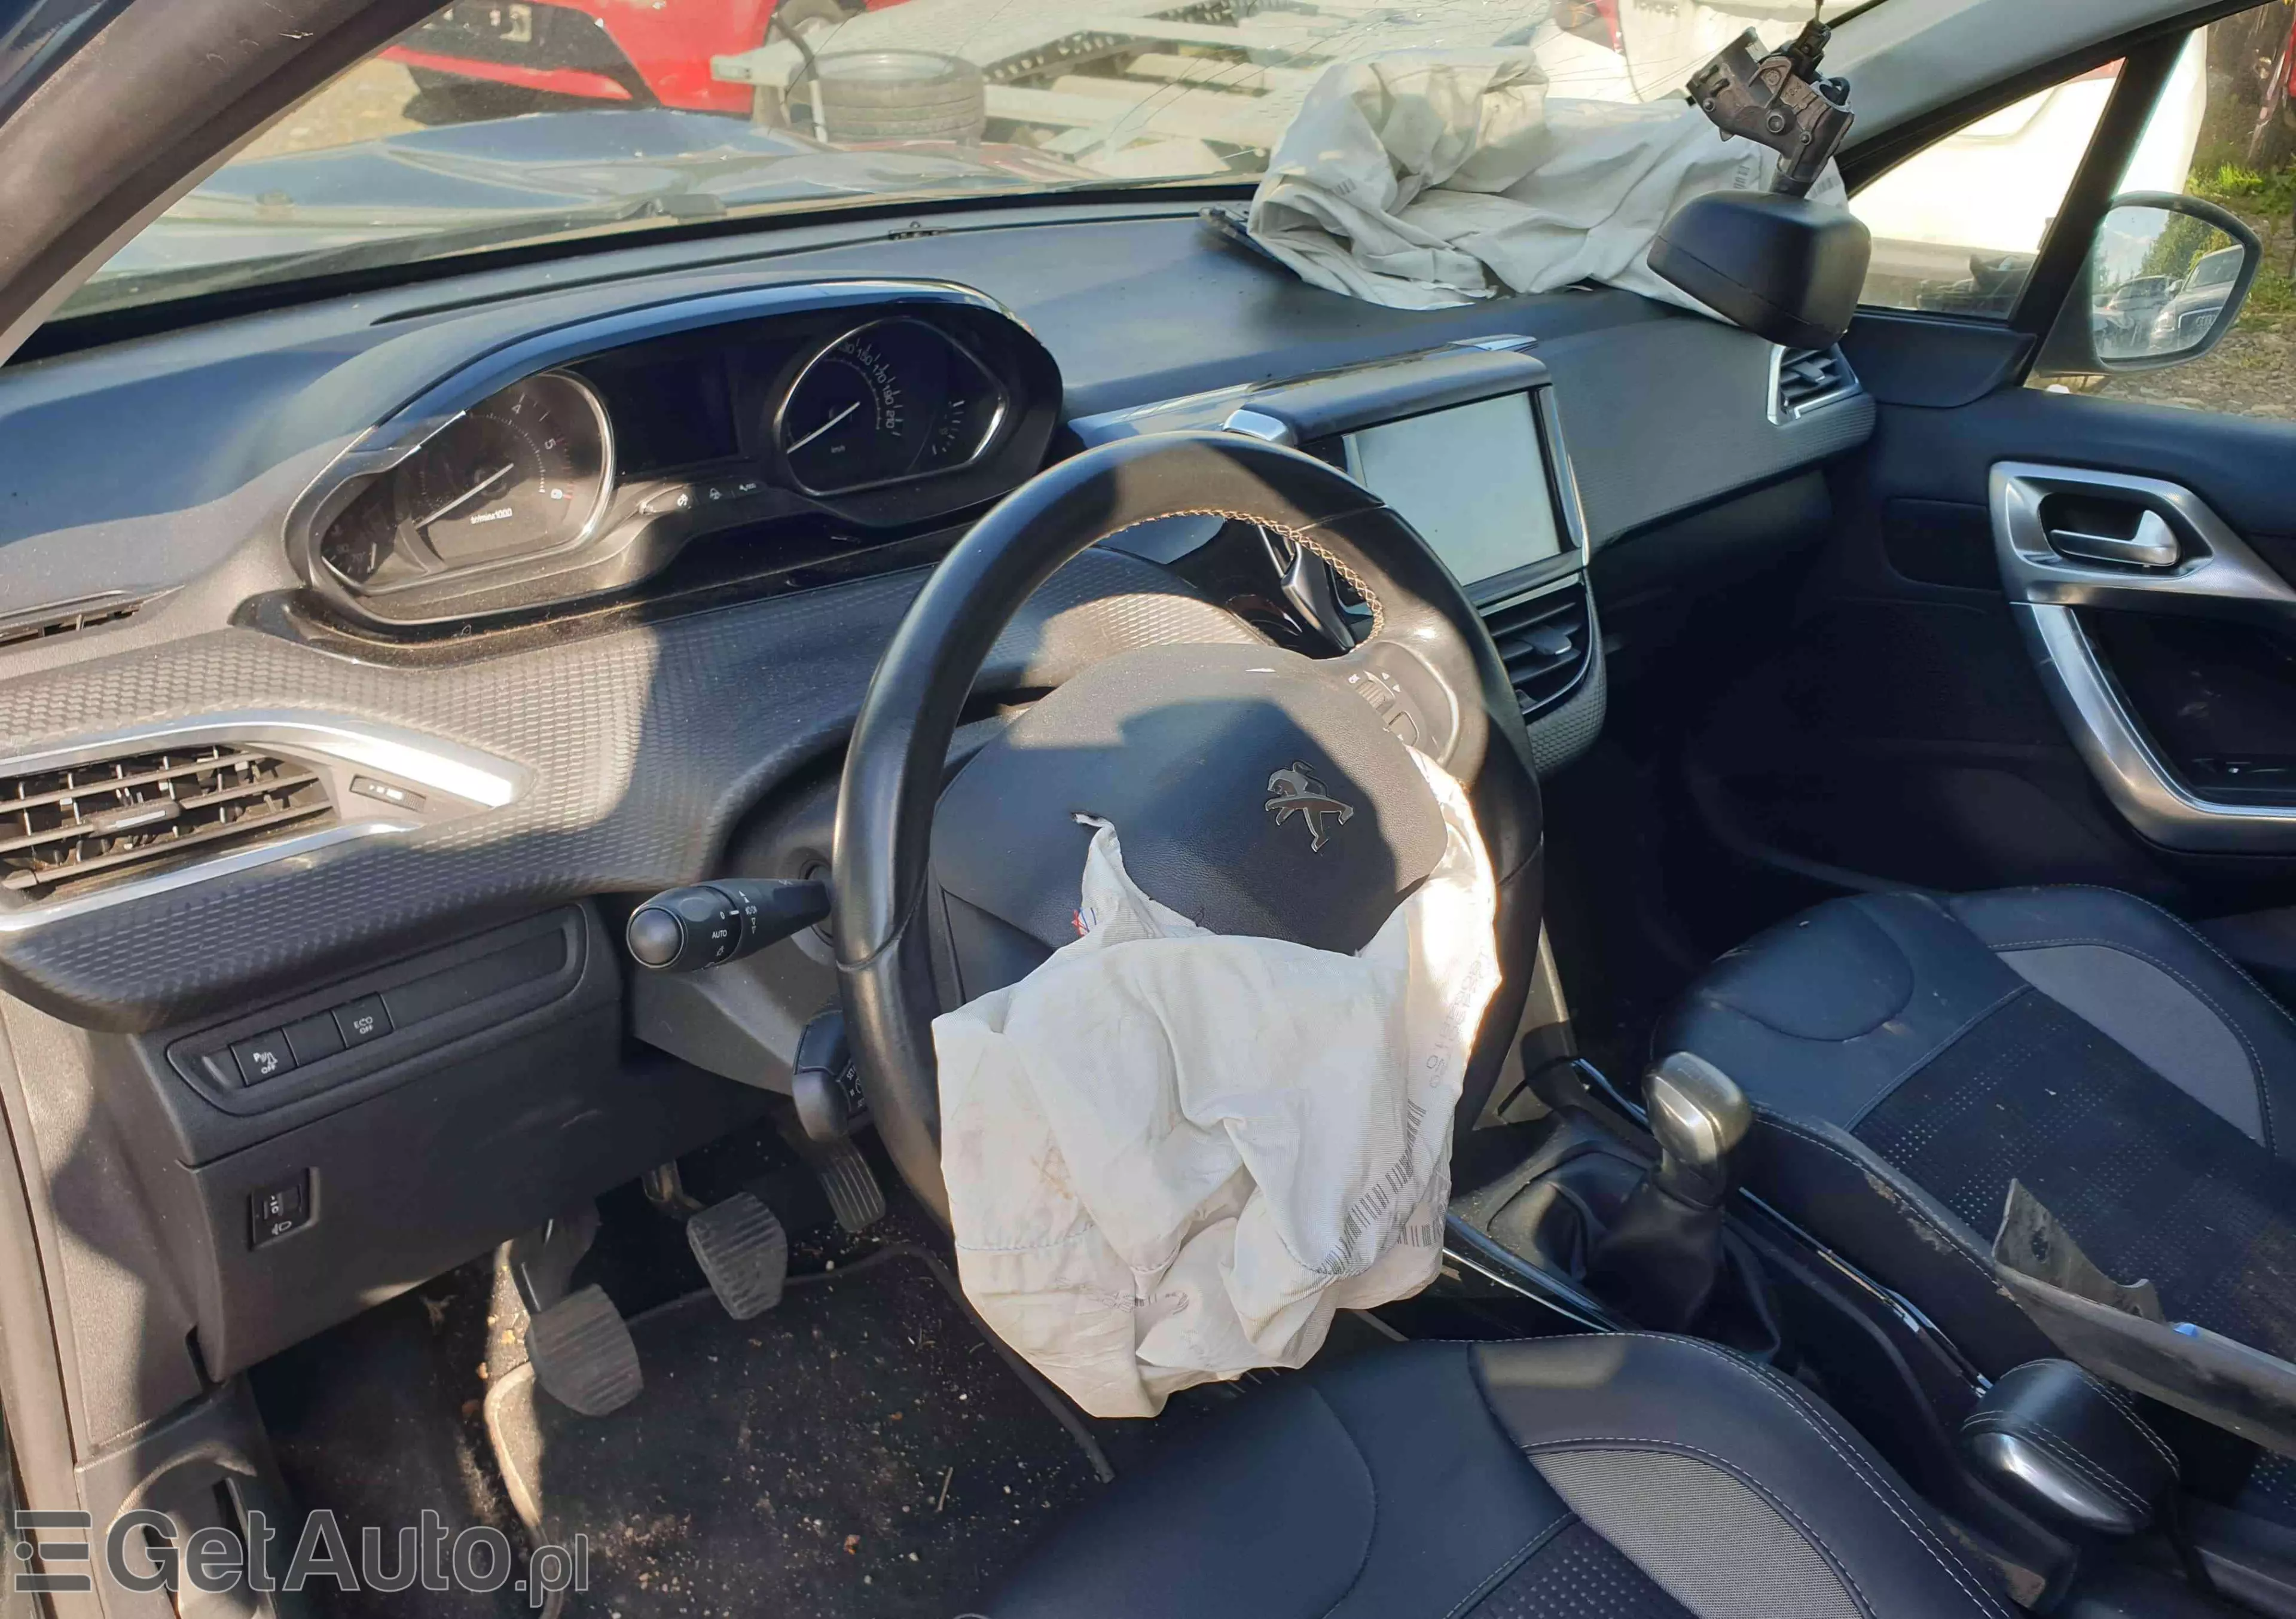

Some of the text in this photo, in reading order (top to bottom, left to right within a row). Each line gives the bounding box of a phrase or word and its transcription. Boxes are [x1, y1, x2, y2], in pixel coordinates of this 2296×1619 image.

[511, 404, 521, 414] 4
[544, 438, 556, 450] 5
[712, 930, 728, 939] AUTO
[353, 1016, 373, 1029] ECO
[359, 1025, 373, 1034] OFF
[261, 1064, 276, 1074] OFF
